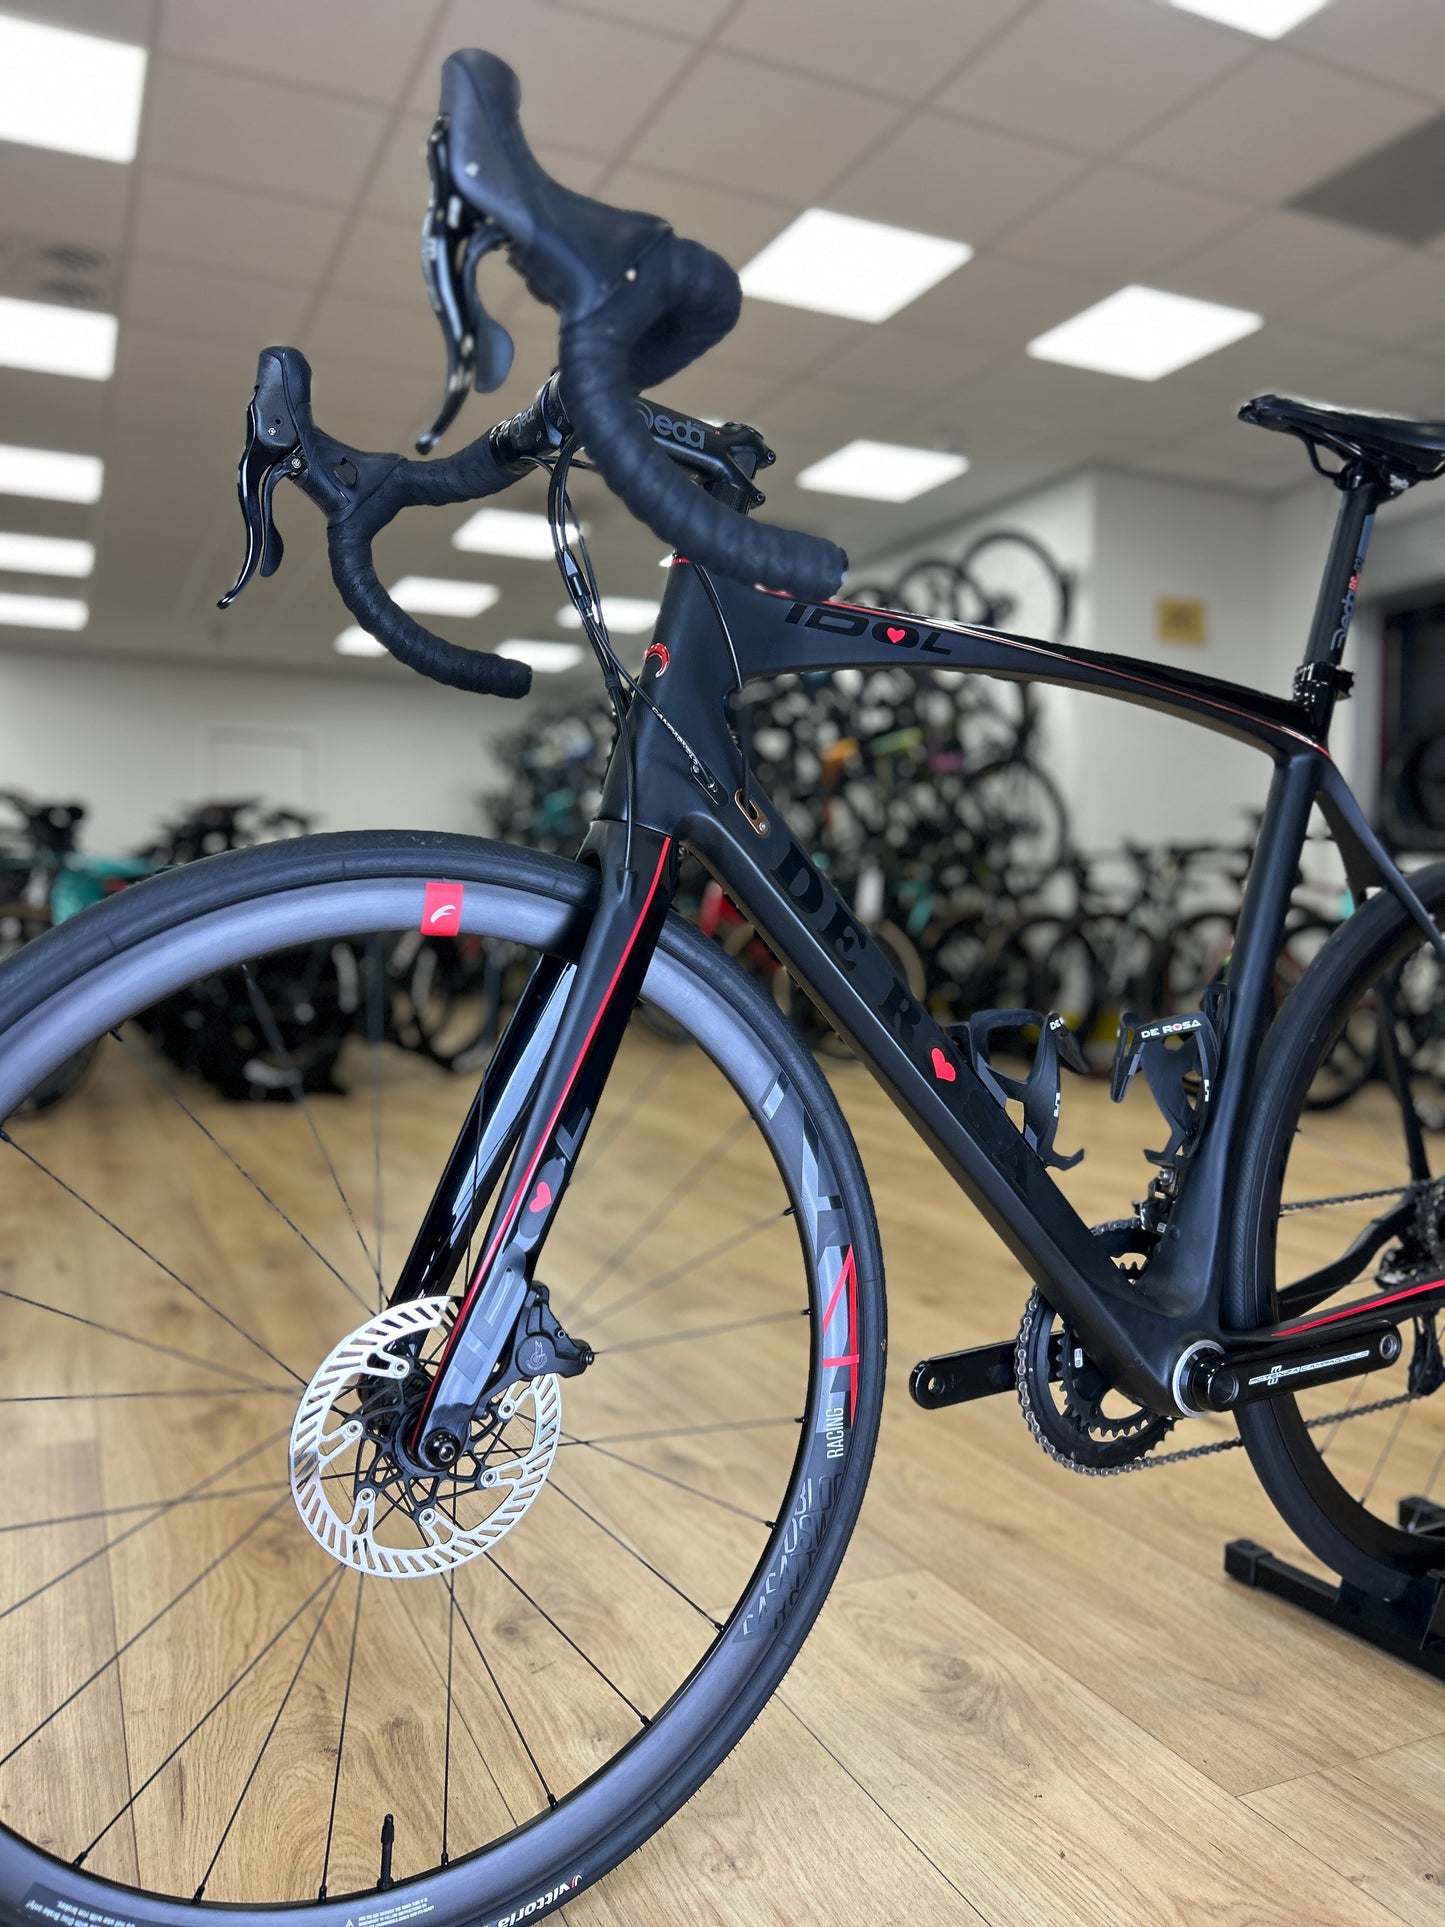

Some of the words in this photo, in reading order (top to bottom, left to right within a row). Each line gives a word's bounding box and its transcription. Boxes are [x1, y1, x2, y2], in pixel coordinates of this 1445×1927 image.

[785, 602, 952, 656] IDOL
[770, 840, 867, 972] DE
[1141, 1027, 1160, 1039] DE
[1162, 1019, 1202, 1035] ROSA
[826, 1407, 845, 1459] RACING
[498, 1882, 571, 1927] vittoria
